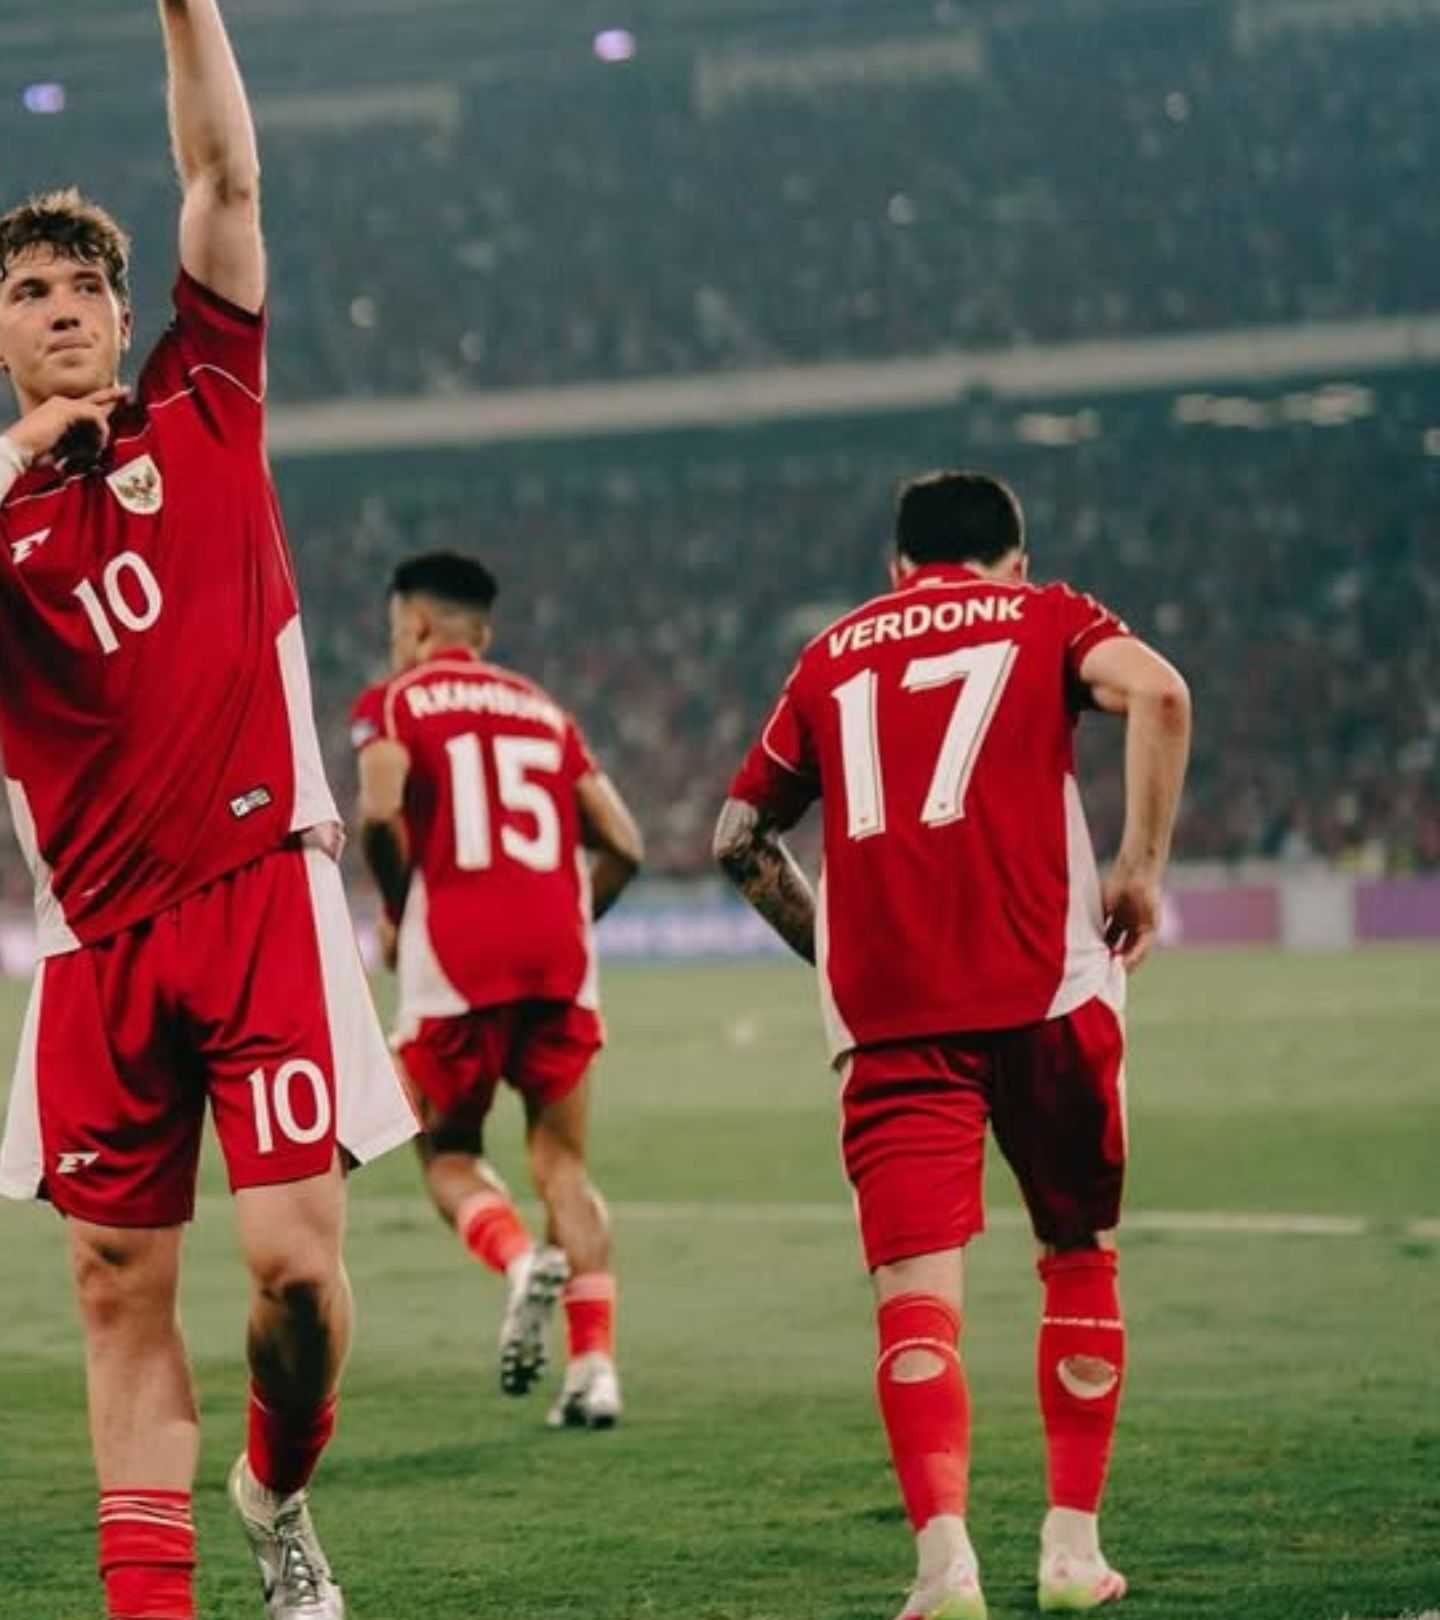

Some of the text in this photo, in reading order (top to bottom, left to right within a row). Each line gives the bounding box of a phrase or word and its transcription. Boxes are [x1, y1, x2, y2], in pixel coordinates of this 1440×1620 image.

[72, 550, 162, 655] 10
[828, 596, 1025, 658] VERDONK
[831, 639, 1020, 841] 17
[445, 731, 561, 872] 15
[249, 1059, 332, 1154] 10
